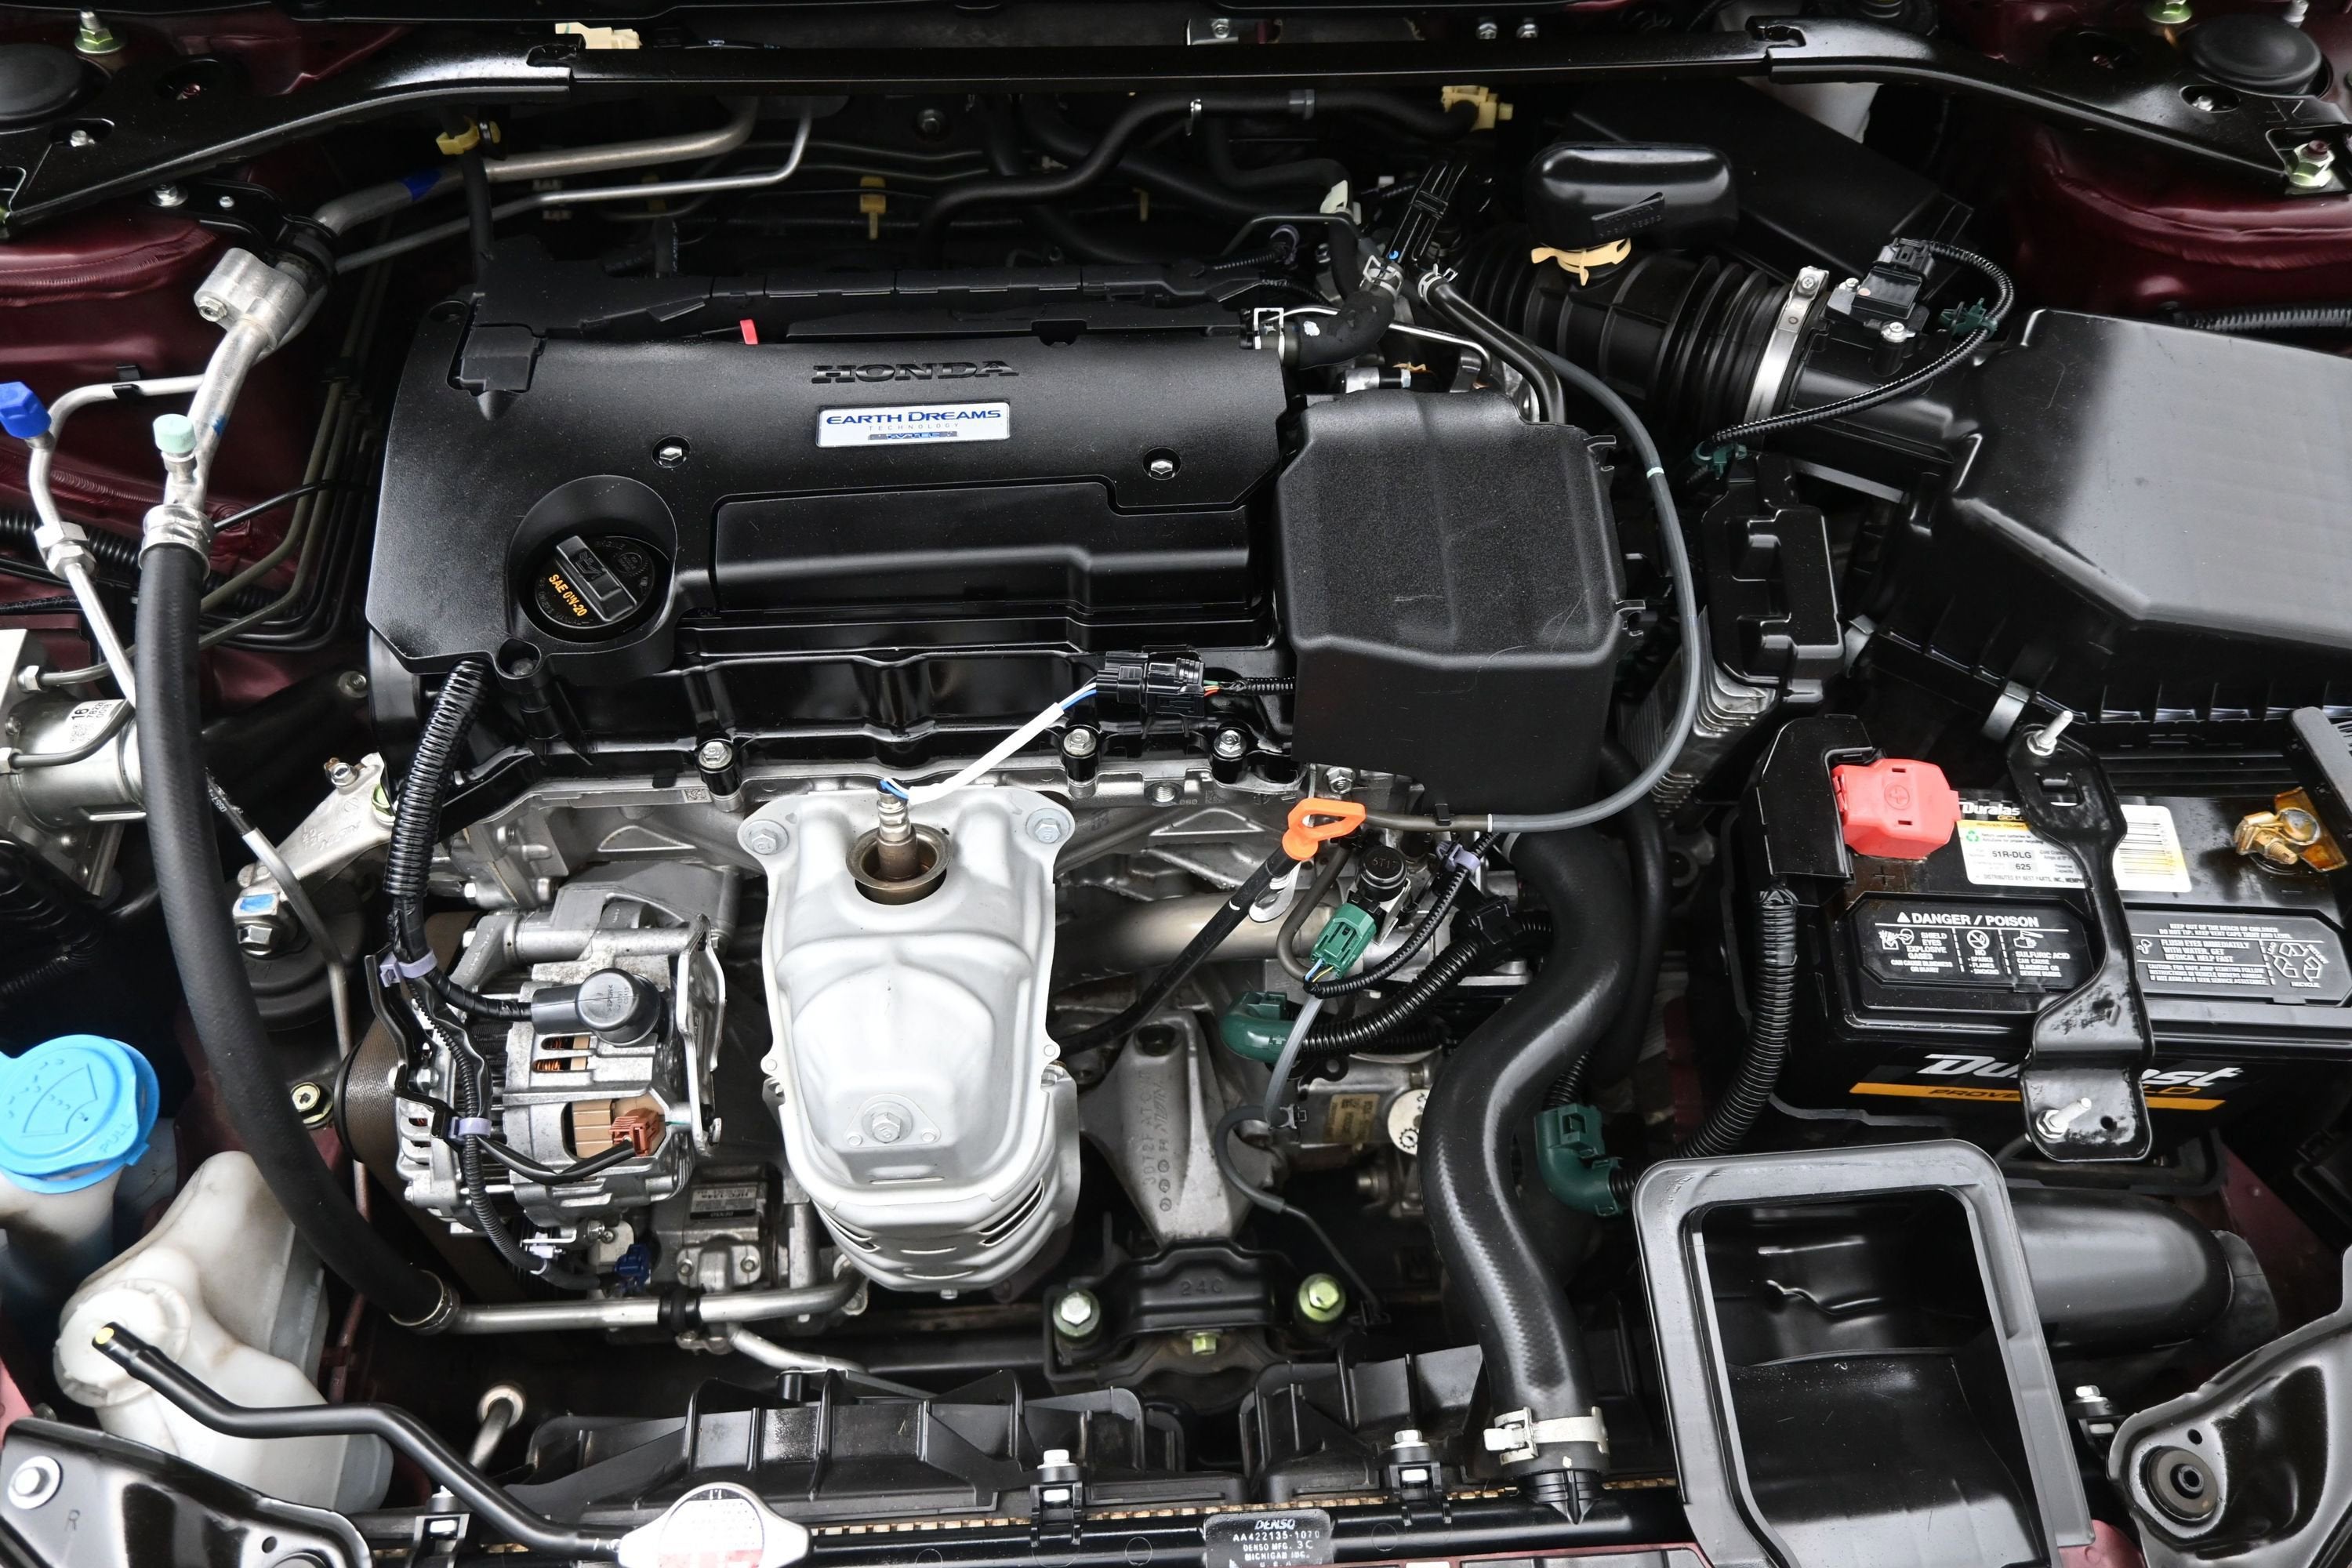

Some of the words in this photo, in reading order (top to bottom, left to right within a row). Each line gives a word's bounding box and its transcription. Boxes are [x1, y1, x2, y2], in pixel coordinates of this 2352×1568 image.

[811, 361, 1018, 383] HONDA
[826, 414, 902, 424] EARTH
[908, 410, 1001, 422] DREAMS
[869, 423, 959, 431] TECHNOLOGY
[549, 574, 568, 593] SAE
[562, 589, 588, 616] 0W-20
[71, 709, 89, 720] 16
[1959, 801, 2020, 816] Duralas
[1911, 913, 1972, 924] DANGER
[1973, 915, 1983, 925] /
[1984, 915, 2039, 927] POISON
[2267, 942, 2277, 954] LEAD
[1929, 1089, 2020, 1098] PROVE
[100, 1123, 132, 1154] PULL
[64, 1508, 81, 1531] R
[1254, 1519, 1296, 1530] DENSO
[1232, 1530, 1320, 1542] AA422135-1070
[1243, 1544, 1269, 1552] DENSO
[1272, 1542, 1292, 1551] MFG.
[1245, 1552, 1287, 1562] MICHIGAN
